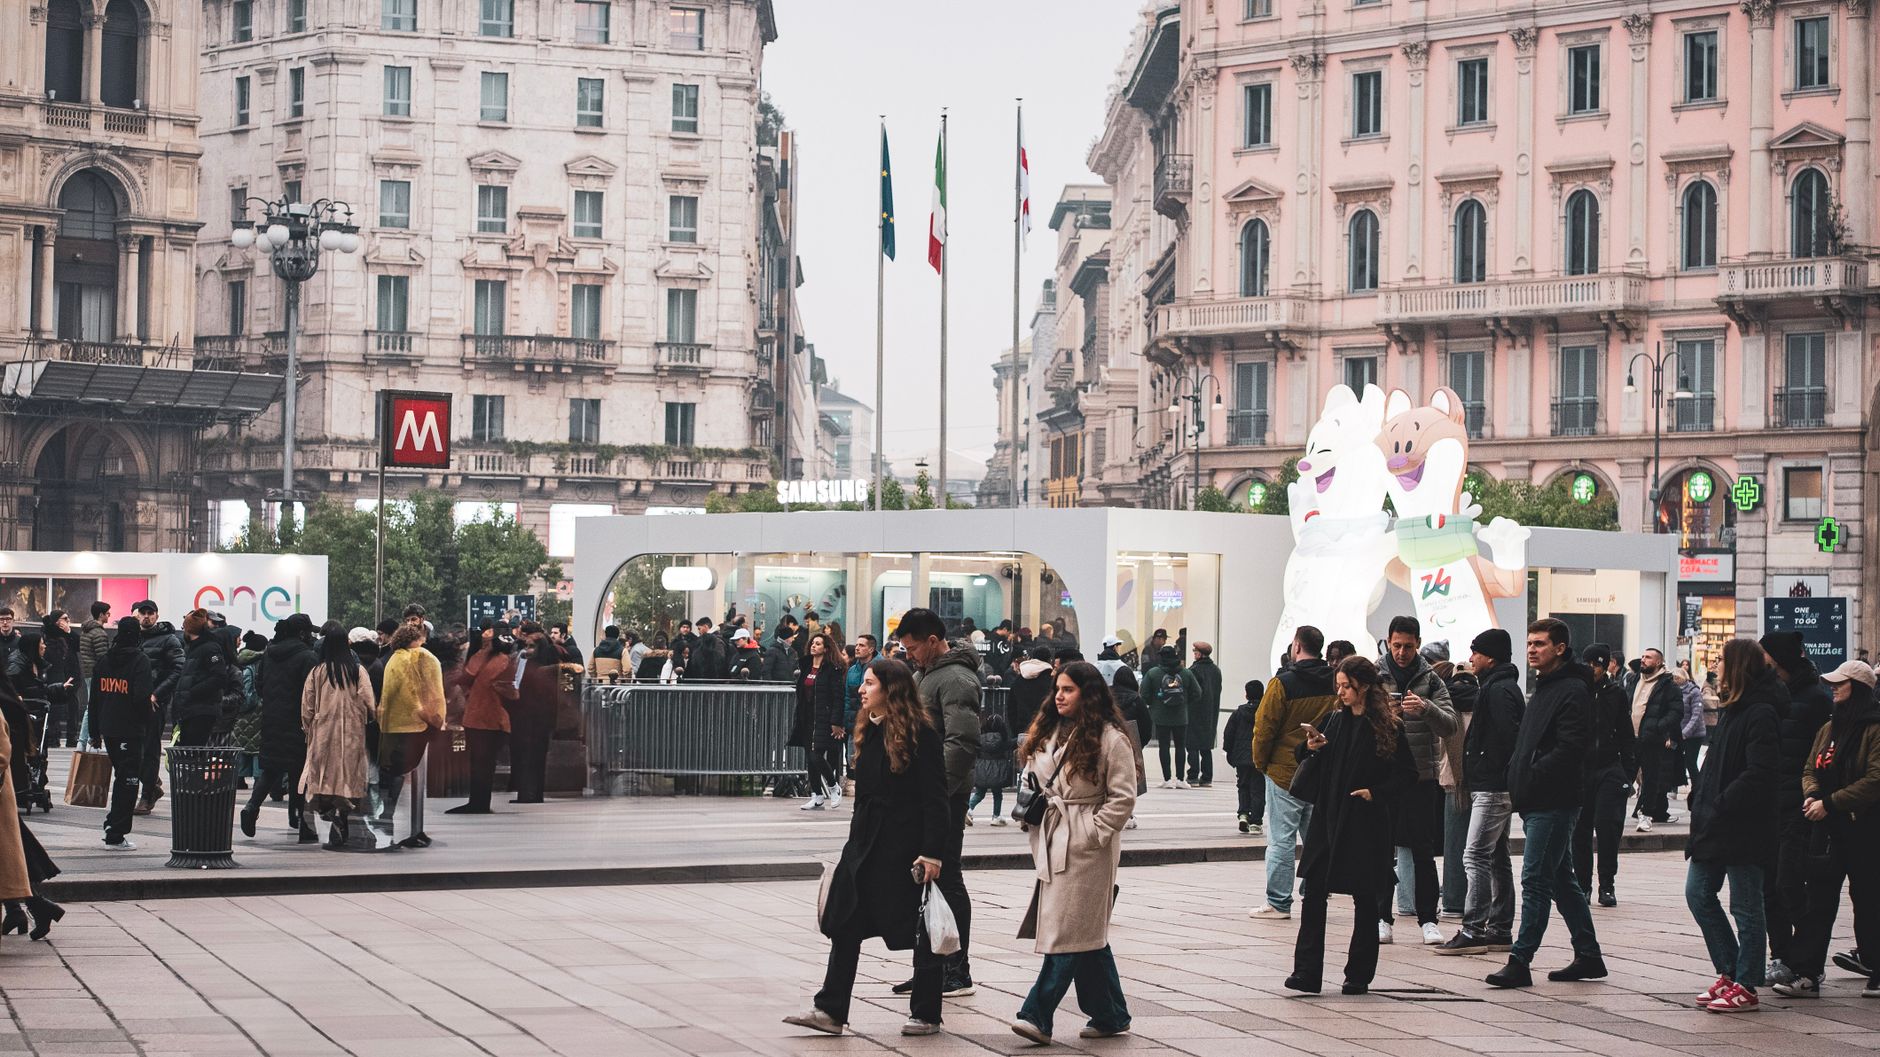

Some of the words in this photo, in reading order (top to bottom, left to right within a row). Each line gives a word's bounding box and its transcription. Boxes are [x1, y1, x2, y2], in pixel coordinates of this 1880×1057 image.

[395, 410, 443, 452] M
[777, 479, 868, 503] SAMSUNG
[194, 576, 300, 622] enel
